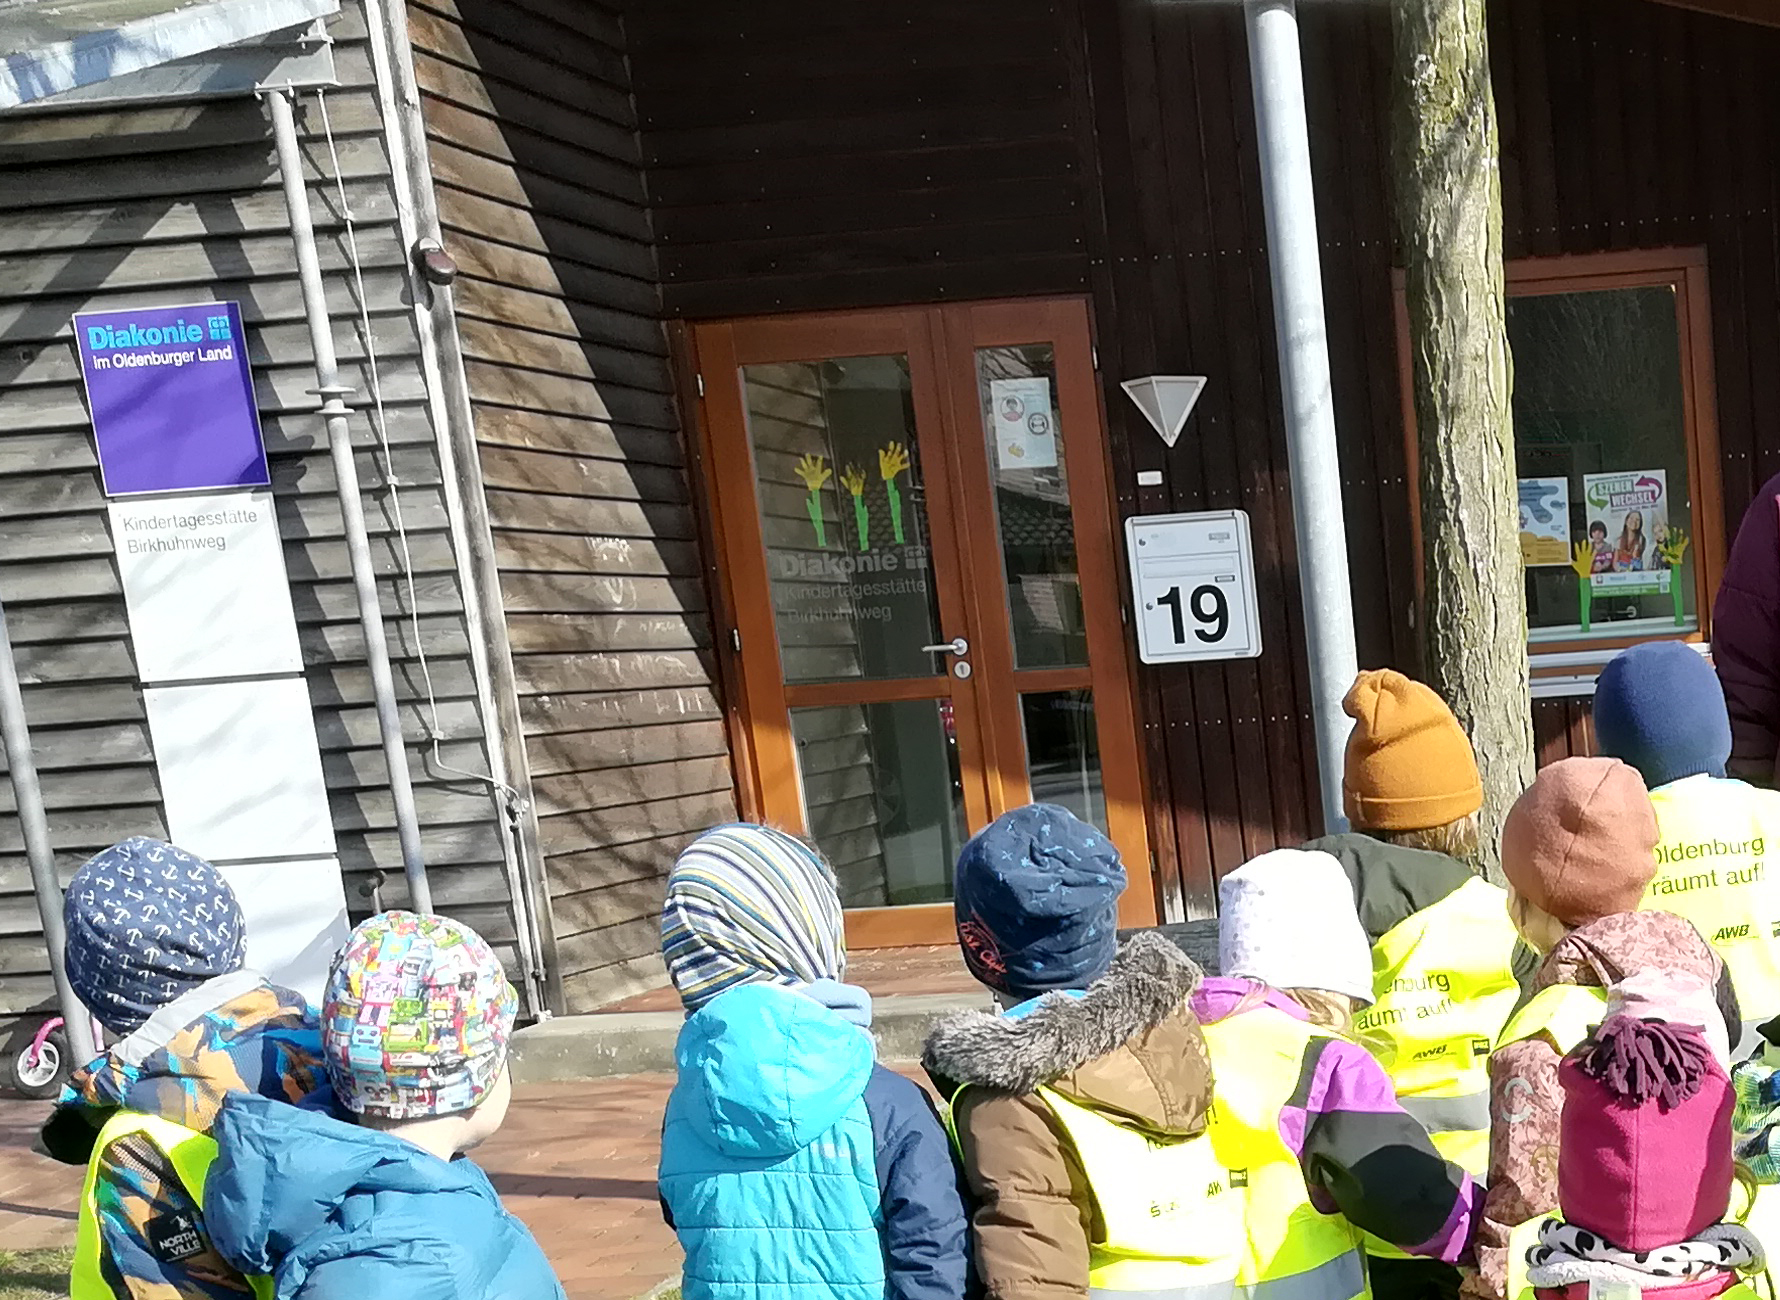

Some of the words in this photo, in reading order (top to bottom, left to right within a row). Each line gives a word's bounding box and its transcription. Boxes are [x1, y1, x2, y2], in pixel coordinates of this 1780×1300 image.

[87, 319, 203, 350] Diakonie
[93, 355, 111, 370] im
[112, 350, 195, 369] Oldenburger
[197, 345, 234, 363] Land
[1611, 491, 1653, 507] WECHSEL
[123, 510, 258, 532] Kindertagesstätte
[128, 535, 226, 554] Birkhuhnweg
[778, 548, 898, 577] Diakonie
[786, 578, 926, 601] Kindertagesstätte
[1156, 584, 1229, 645] 19
[1652, 869, 1719, 896] räumt
[1714, 924, 1750, 941] AWB
[159, 1230, 198, 1250] NORTH
[170, 1240, 201, 1256] VILLE
